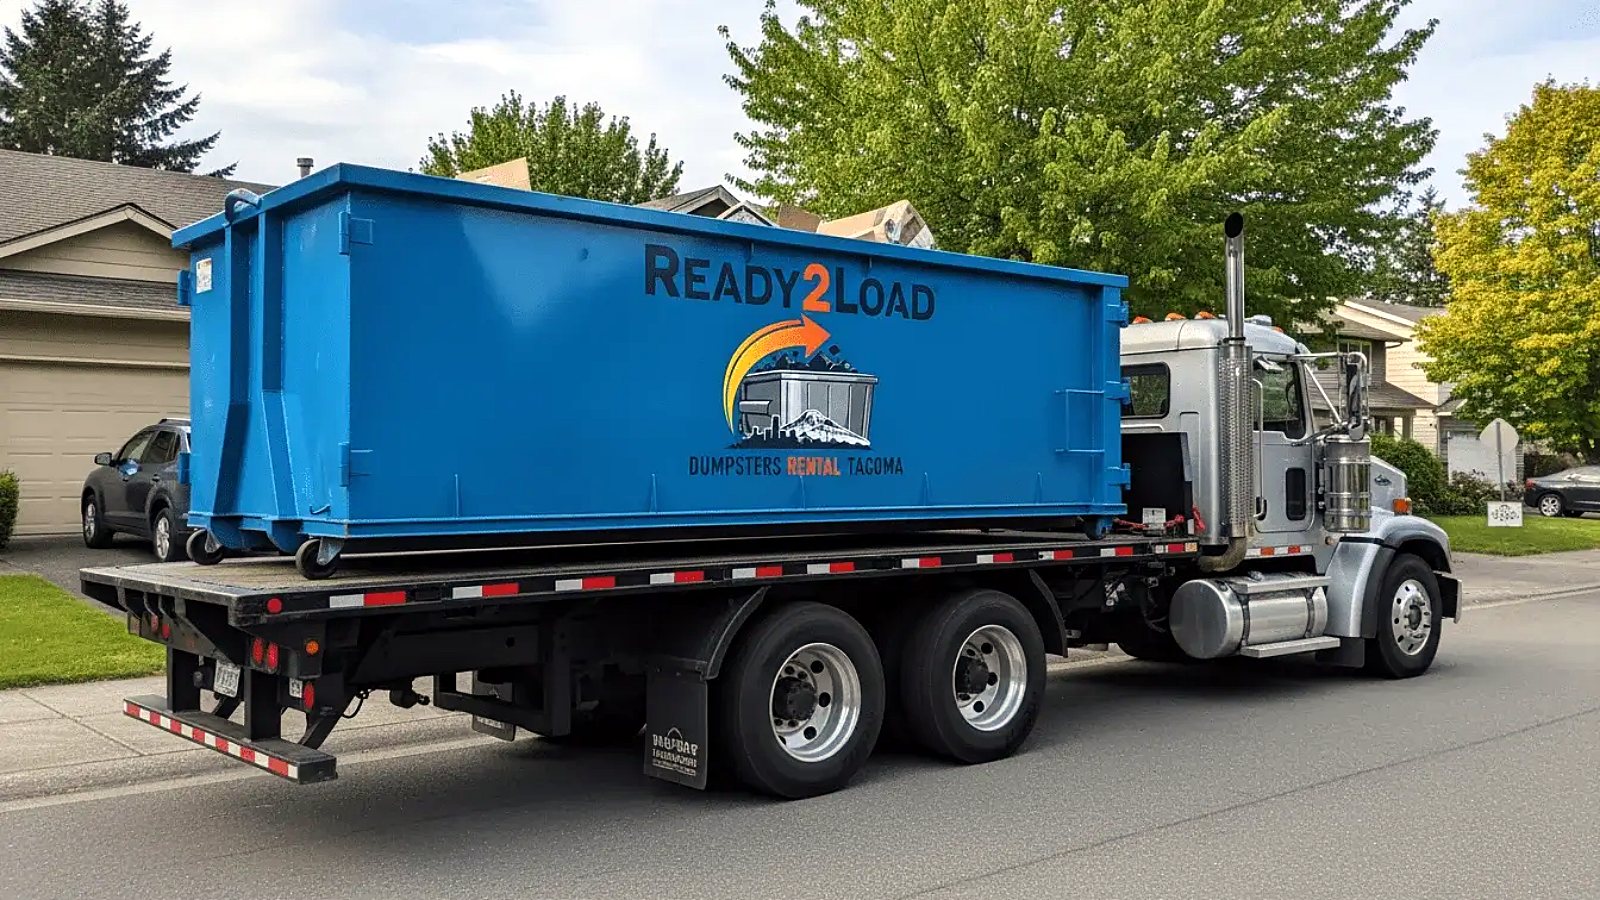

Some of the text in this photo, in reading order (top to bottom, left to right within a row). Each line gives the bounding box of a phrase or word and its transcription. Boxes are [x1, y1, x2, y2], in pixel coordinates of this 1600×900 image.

[688, 456, 904, 477] DUMPSTERS RENTAL TACOMA
